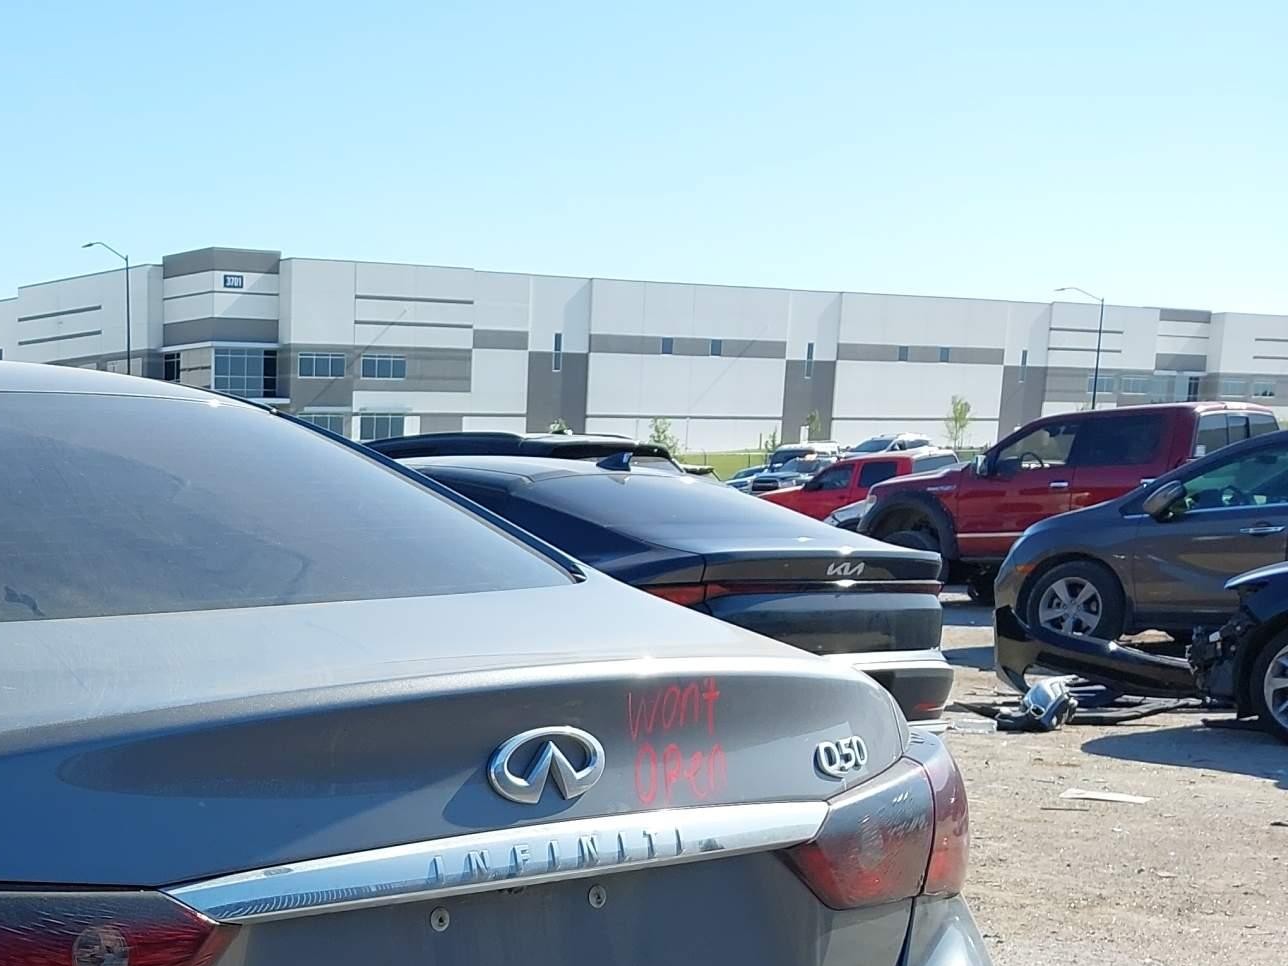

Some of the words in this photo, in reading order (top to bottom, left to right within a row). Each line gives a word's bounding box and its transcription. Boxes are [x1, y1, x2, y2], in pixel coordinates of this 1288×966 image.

[225, 276, 242, 287] 3701
[826, 561, 865, 576] KIA
[814, 735, 869, 781] Q50
[429, 828, 685, 885] INFINITI
